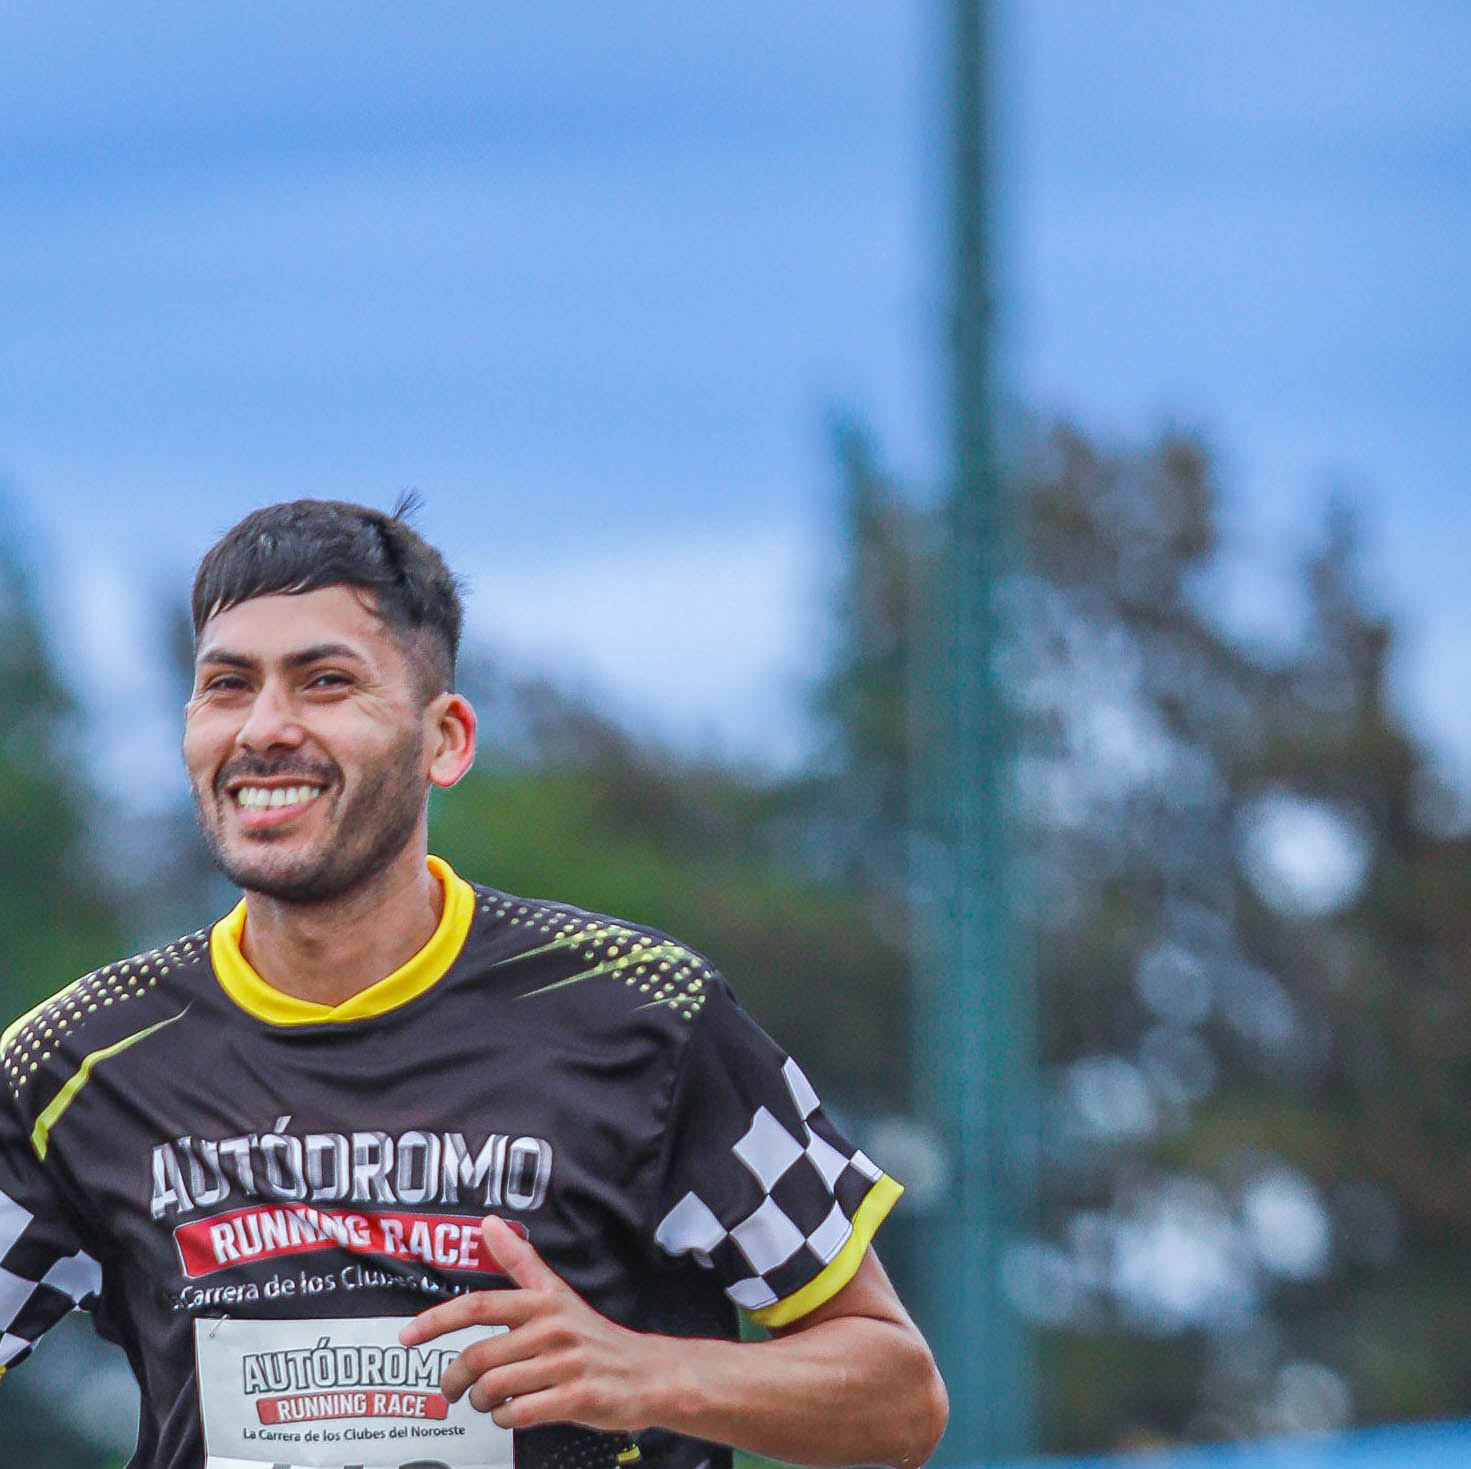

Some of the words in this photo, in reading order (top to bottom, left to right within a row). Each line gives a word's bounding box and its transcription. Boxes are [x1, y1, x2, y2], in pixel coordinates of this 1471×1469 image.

[150, 1115, 554, 1221] AUTÓDROMO
[209, 1206, 371, 1265] RUNNING
[377, 1216, 483, 1267] RACE
[179, 1281, 259, 1311] Carrera
[263, 1272, 296, 1298] de
[301, 1270, 335, 1295] los
[277, 1394, 367, 1423] RUNNING
[373, 1394, 426, 1418] RACE
[243, 1427, 257, 1440] La
[259, 1428, 301, 1442] Carrera
[304, 1429, 320, 1442] de
[323, 1429, 341, 1442] los
[344, 1427, 386, 1440] Clubes
[389, 1424, 408, 1438] del
[411, 1424, 466, 1437] Noroeste
